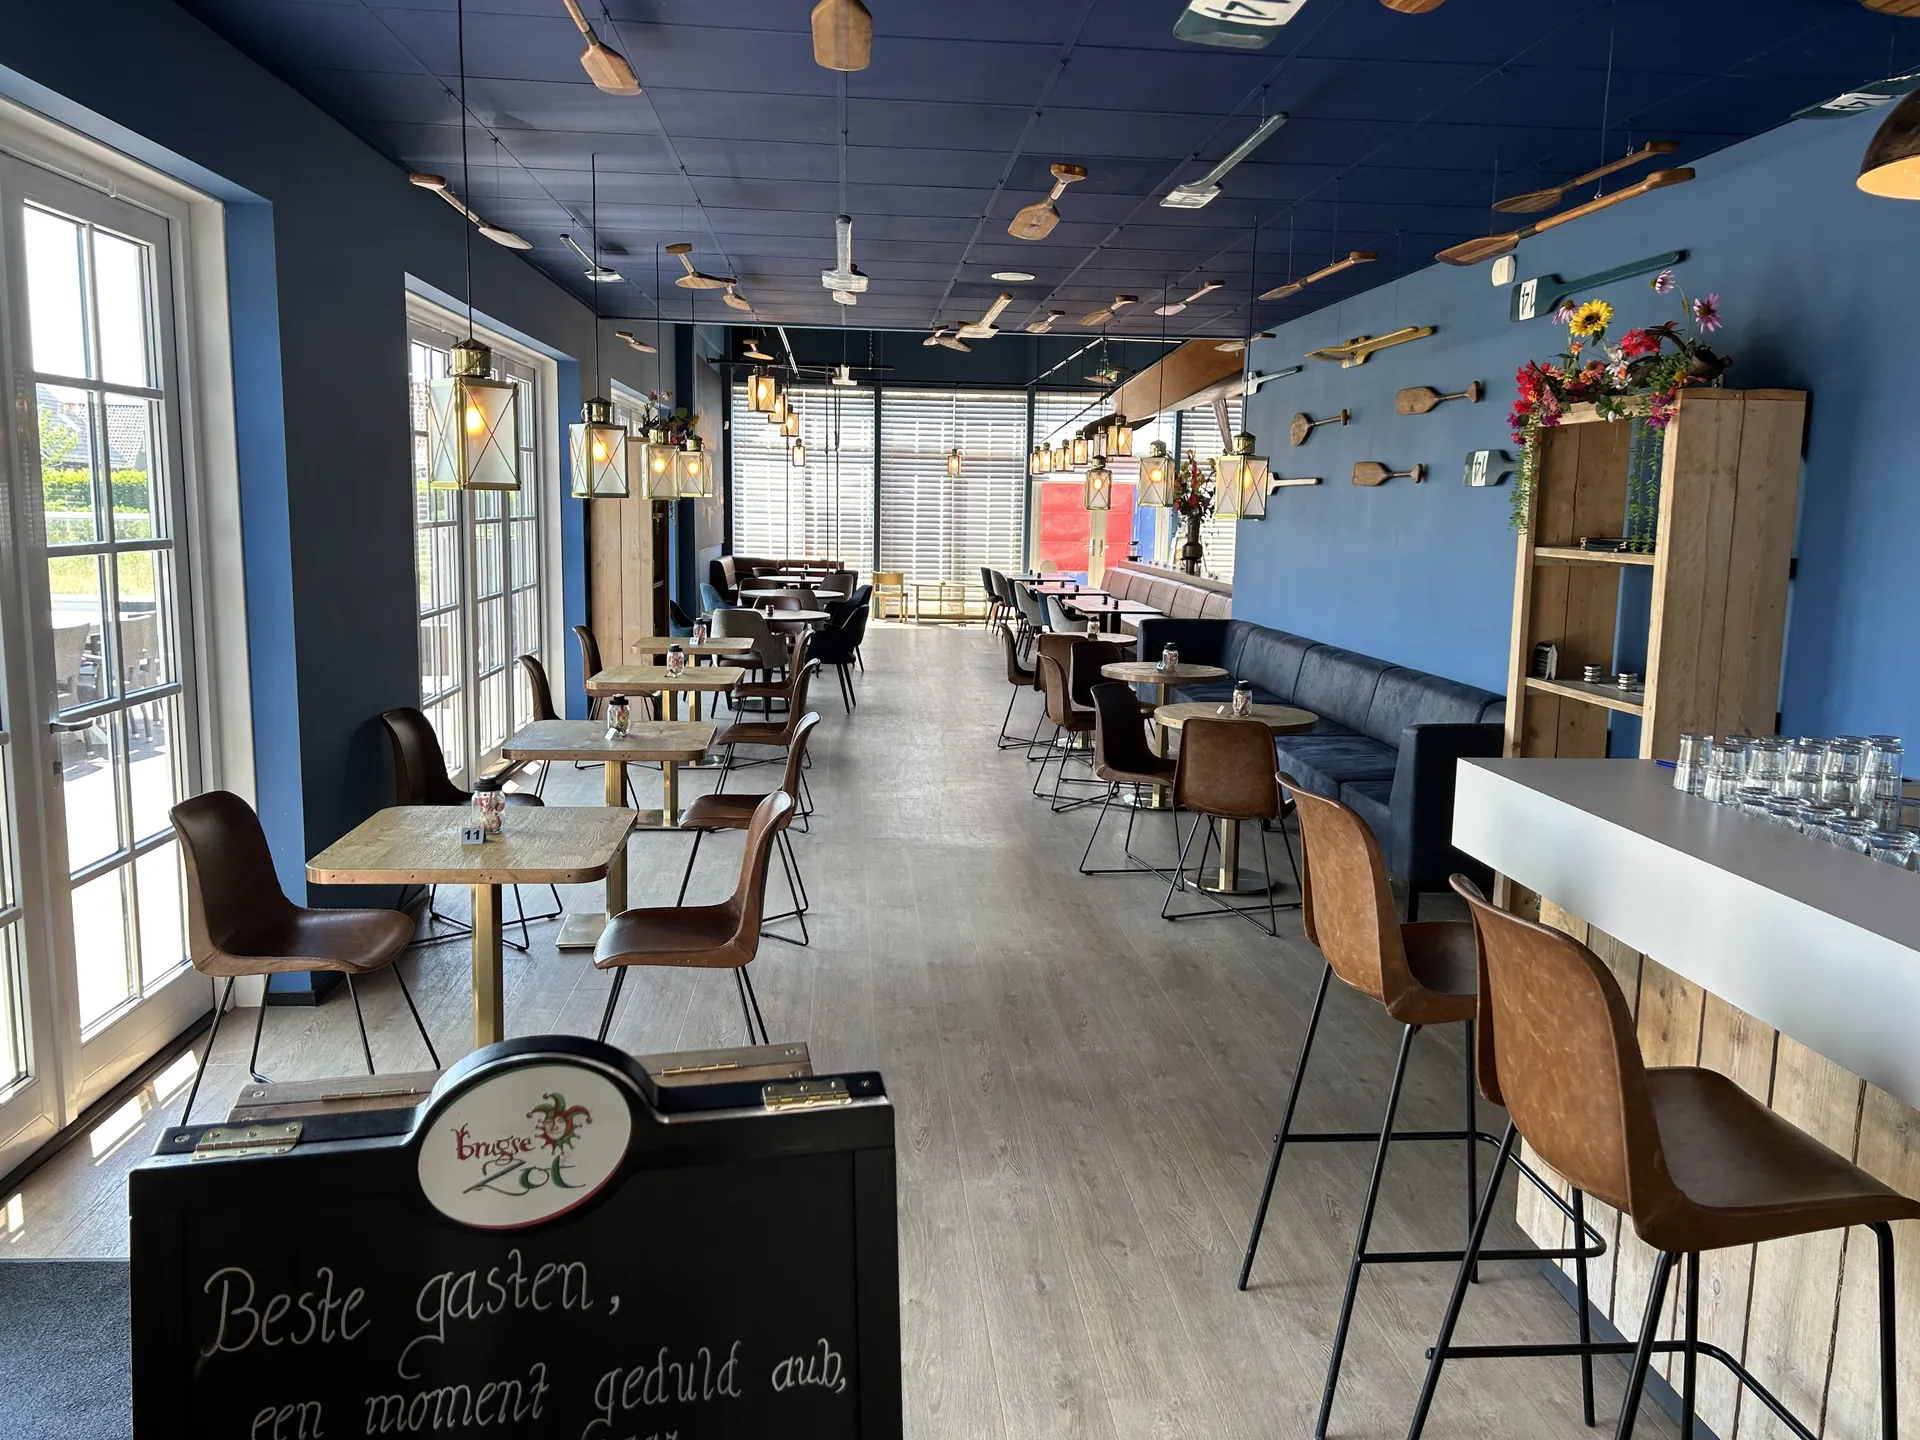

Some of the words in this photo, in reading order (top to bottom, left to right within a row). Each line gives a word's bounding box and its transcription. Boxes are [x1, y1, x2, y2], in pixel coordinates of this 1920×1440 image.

[464, 829, 481, 841] 11
[201, 1266, 371, 1357] Beste
[251, 1400, 325, 1440] een
[365, 1362, 550, 1435] moment
[581, 1339, 742, 1440] geduld
[771, 1337, 847, 1393] aub,
